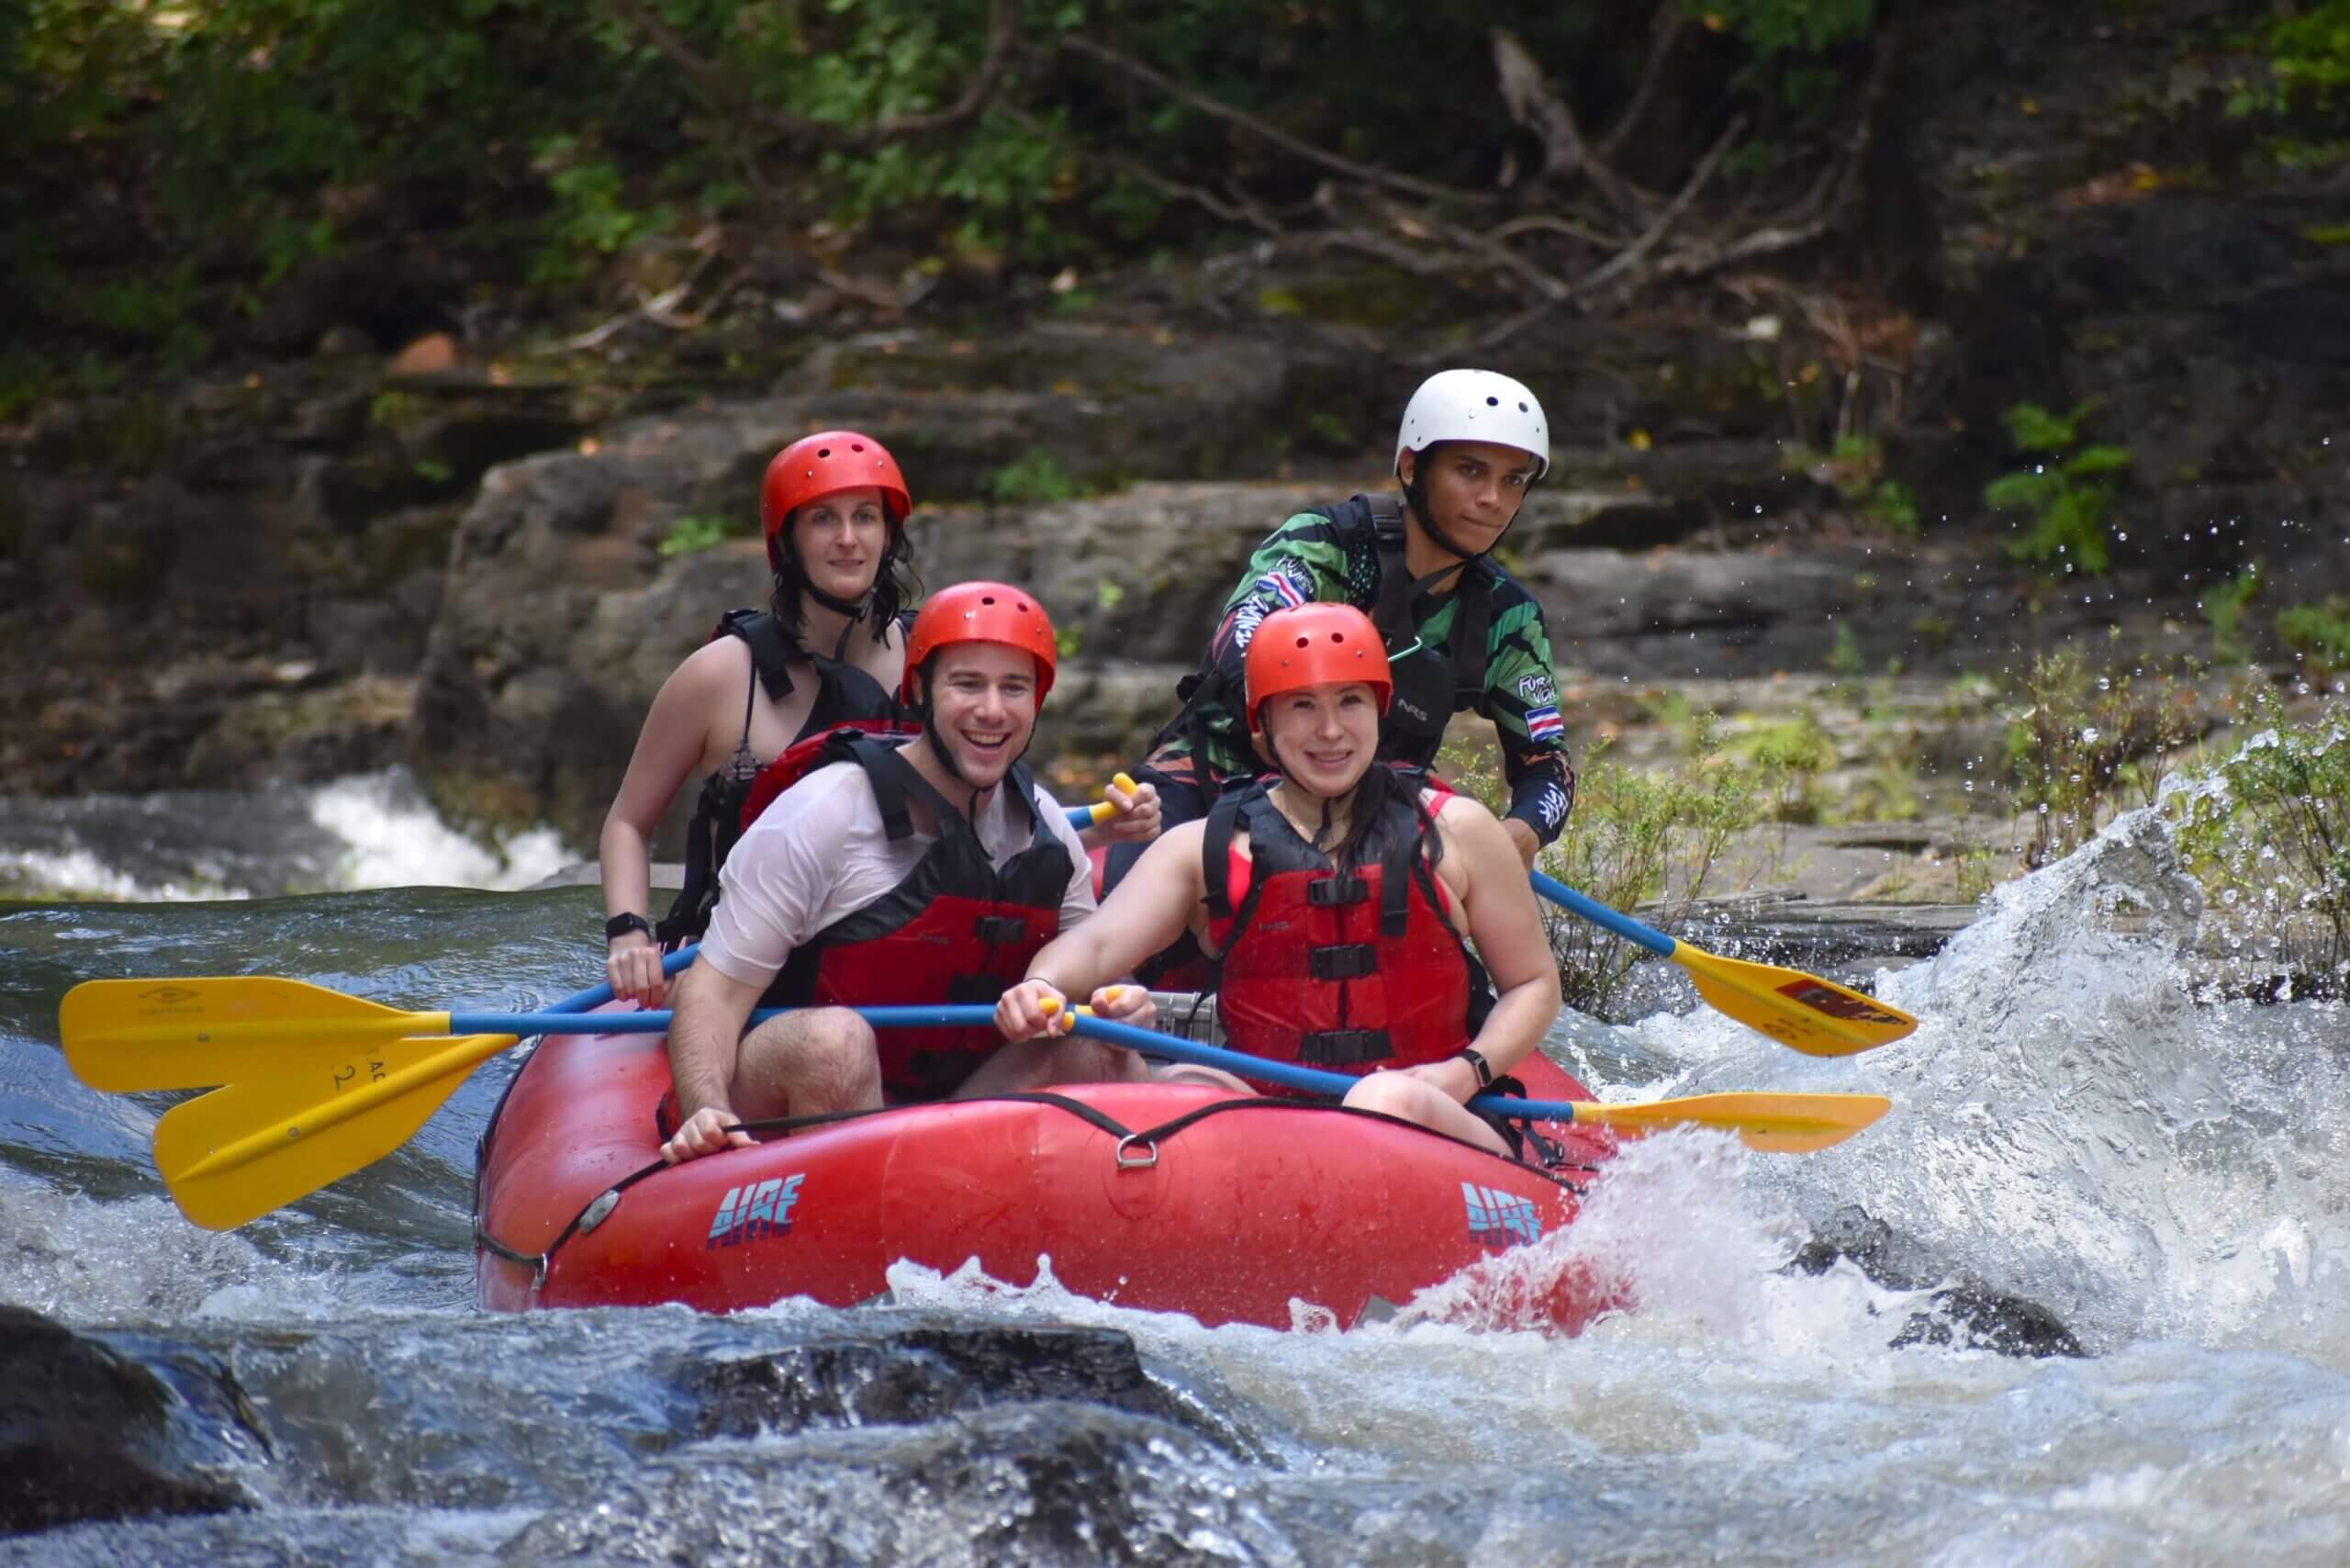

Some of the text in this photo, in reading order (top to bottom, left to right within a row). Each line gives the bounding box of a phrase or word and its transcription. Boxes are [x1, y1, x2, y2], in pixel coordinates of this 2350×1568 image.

[1397, 698, 1428, 722] NRS
[708, 1173, 806, 1239] AIRE
[1460, 1182, 1542, 1244] AIRE
